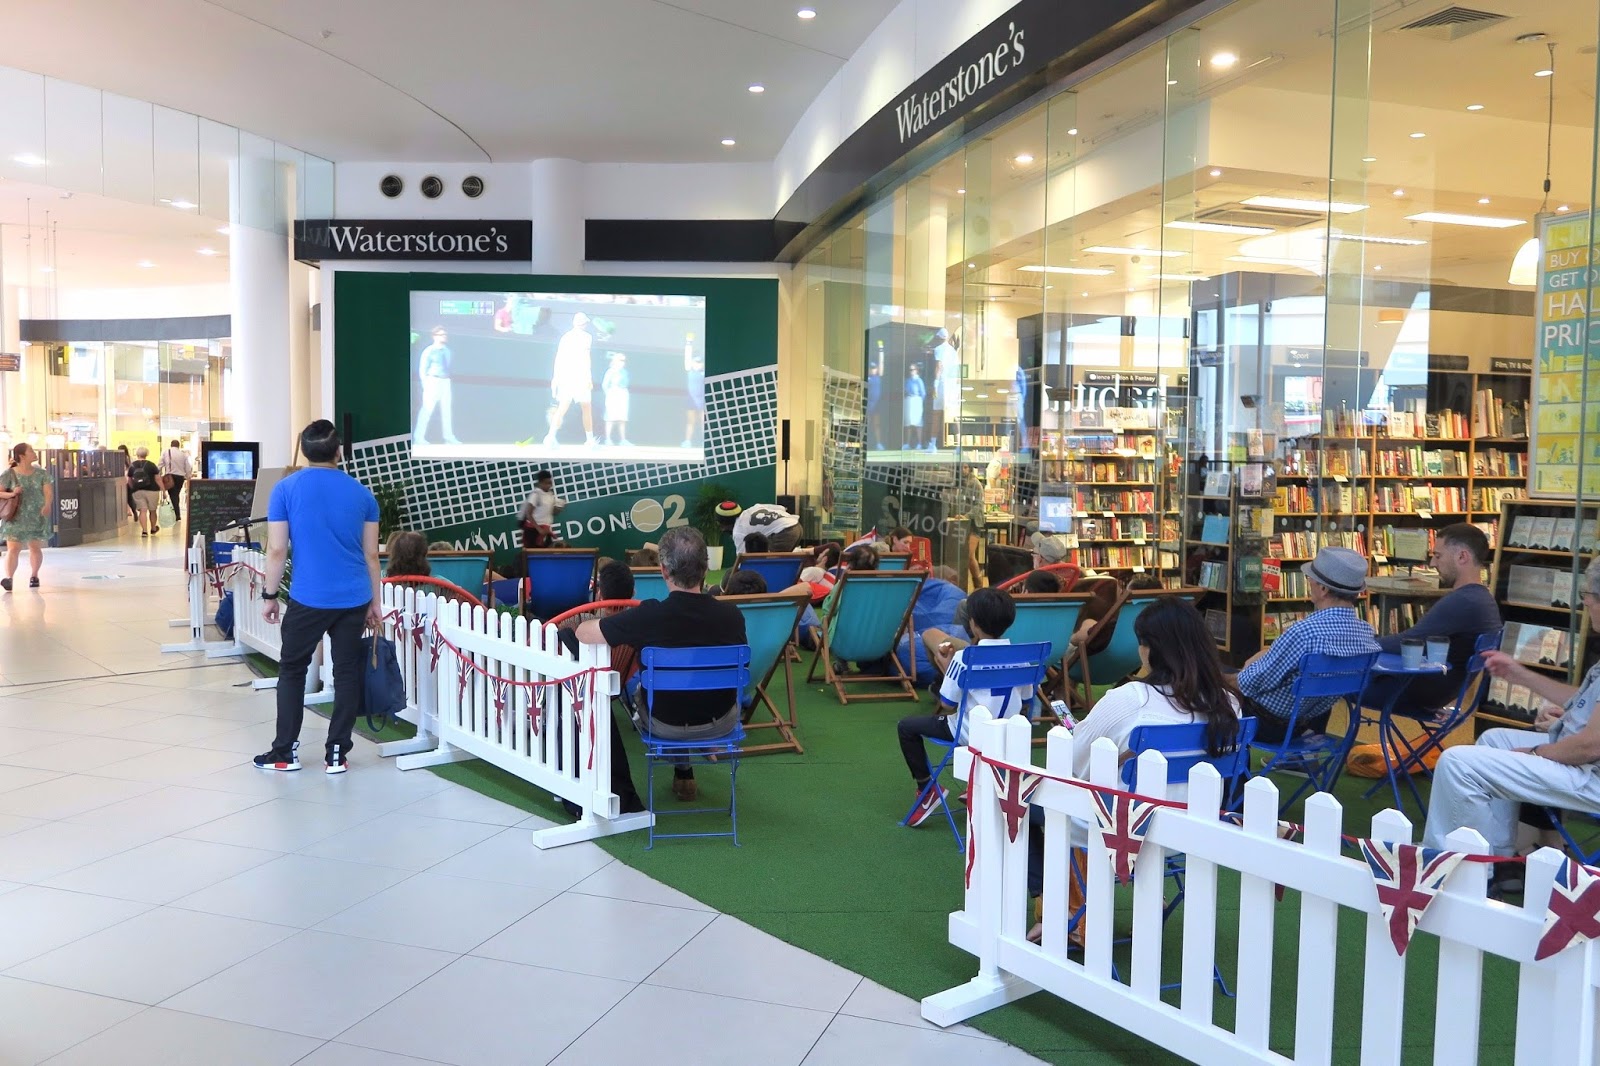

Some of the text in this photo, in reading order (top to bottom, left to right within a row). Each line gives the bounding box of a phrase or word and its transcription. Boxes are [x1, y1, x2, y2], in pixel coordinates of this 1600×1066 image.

[894, 21, 1026, 144] Waterstone's
[328, 226, 508, 253] Waterstone's
[1549, 250, 1580, 269] BUY
[1549, 271, 1579, 288] GET
[1292, 352, 1309, 360] Sport
[1089, 373, 1111, 381] ience
[1112, 374, 1129, 382] Ftion
[1135, 375, 1156, 383] Fantasy
[60, 498, 79, 511] SOHO
[990, 687, 1013, 719] 7
